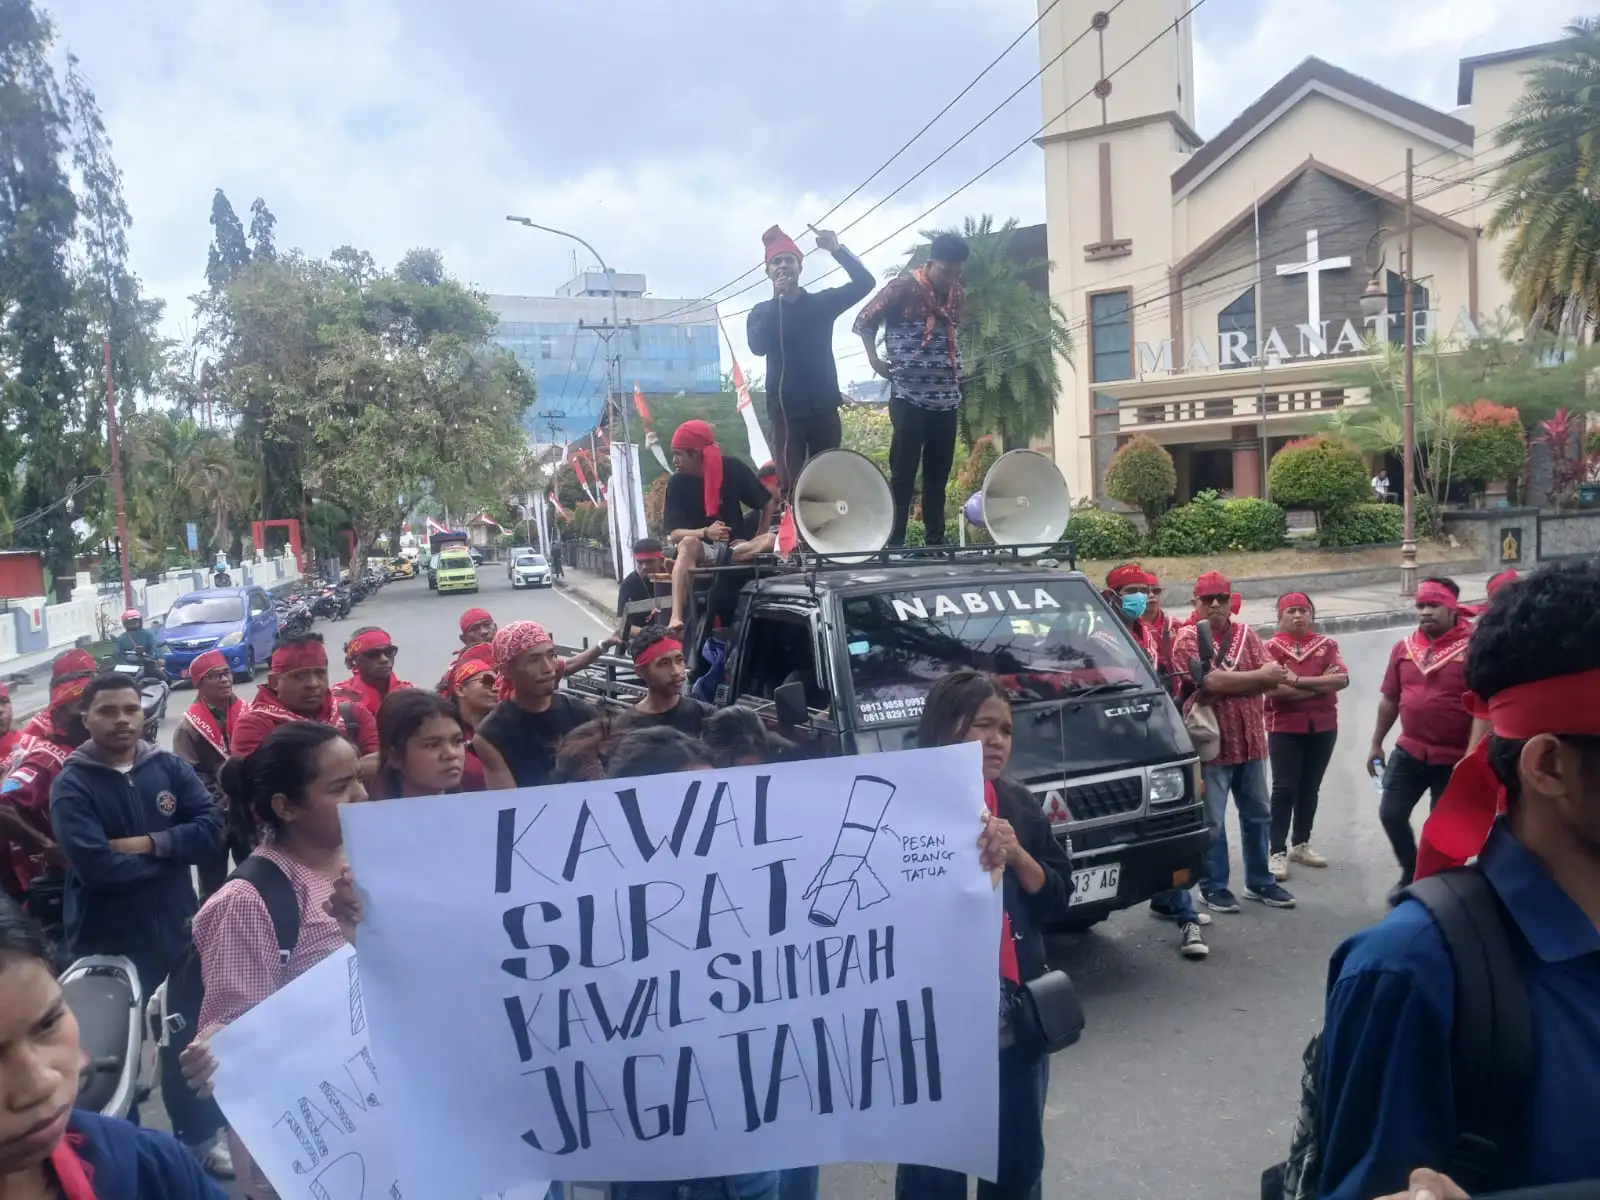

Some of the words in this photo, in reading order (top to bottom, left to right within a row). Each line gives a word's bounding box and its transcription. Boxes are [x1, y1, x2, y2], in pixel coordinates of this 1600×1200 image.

[1135, 305, 1480, 377] MARANATHA
[892, 588, 1061, 621] NABILA
[860, 702, 882, 712] 0813
[863, 712, 885, 722] 0813
[1104, 703, 1150, 718] COLT
[495, 775, 803, 893] KAWAL
[902, 834, 946, 852] PESAN
[902, 850, 956, 864] ORANG
[901, 865, 948, 882] TATUA
[1099, 868, 1118, 889] AG
[501, 858, 797, 981] SURAT
[503, 970, 706, 1063] KAWAL
[706, 925, 895, 1014] SUMPAH
[520, 1046, 718, 1155] JAGA
[718, 987, 942, 1132] TANAH
